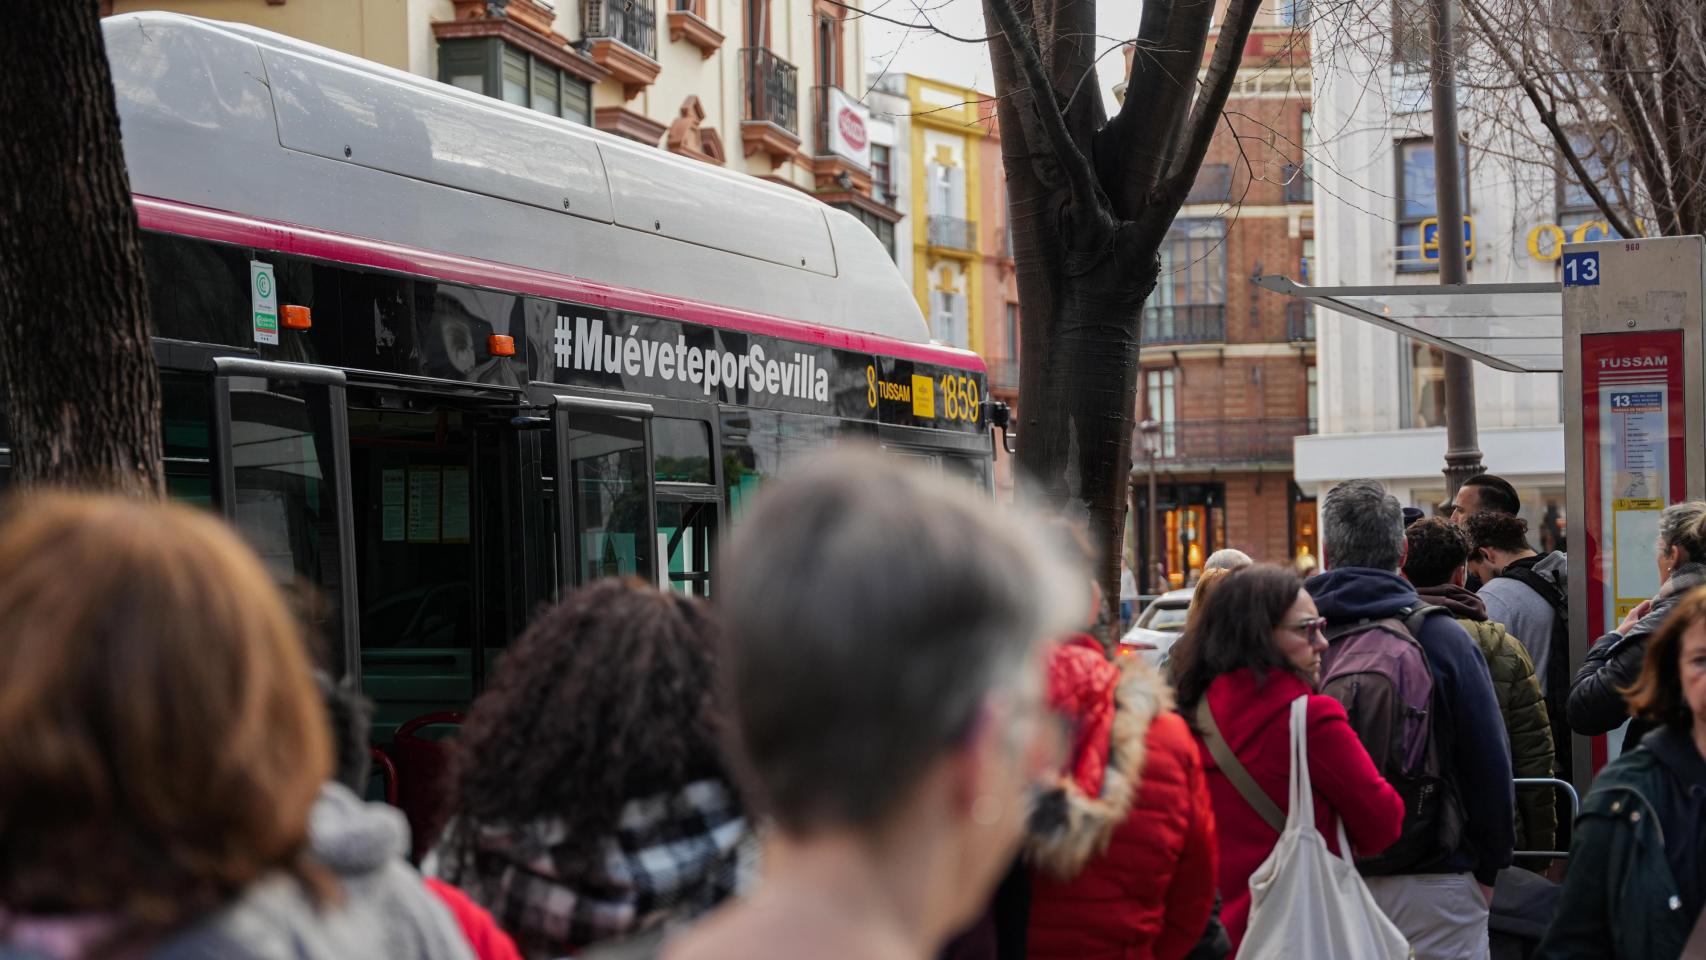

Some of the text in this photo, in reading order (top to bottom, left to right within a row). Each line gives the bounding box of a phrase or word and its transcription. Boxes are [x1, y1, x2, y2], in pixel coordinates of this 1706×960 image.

[1566, 257, 1598, 282] 13
[554, 315, 828, 401] #MuéveteporSevilla
[1599, 355, 1668, 369] TUSSAM
[878, 381, 911, 402] TUSSAM
[941, 374, 979, 423] 1859
[1613, 395, 1630, 407] 13
